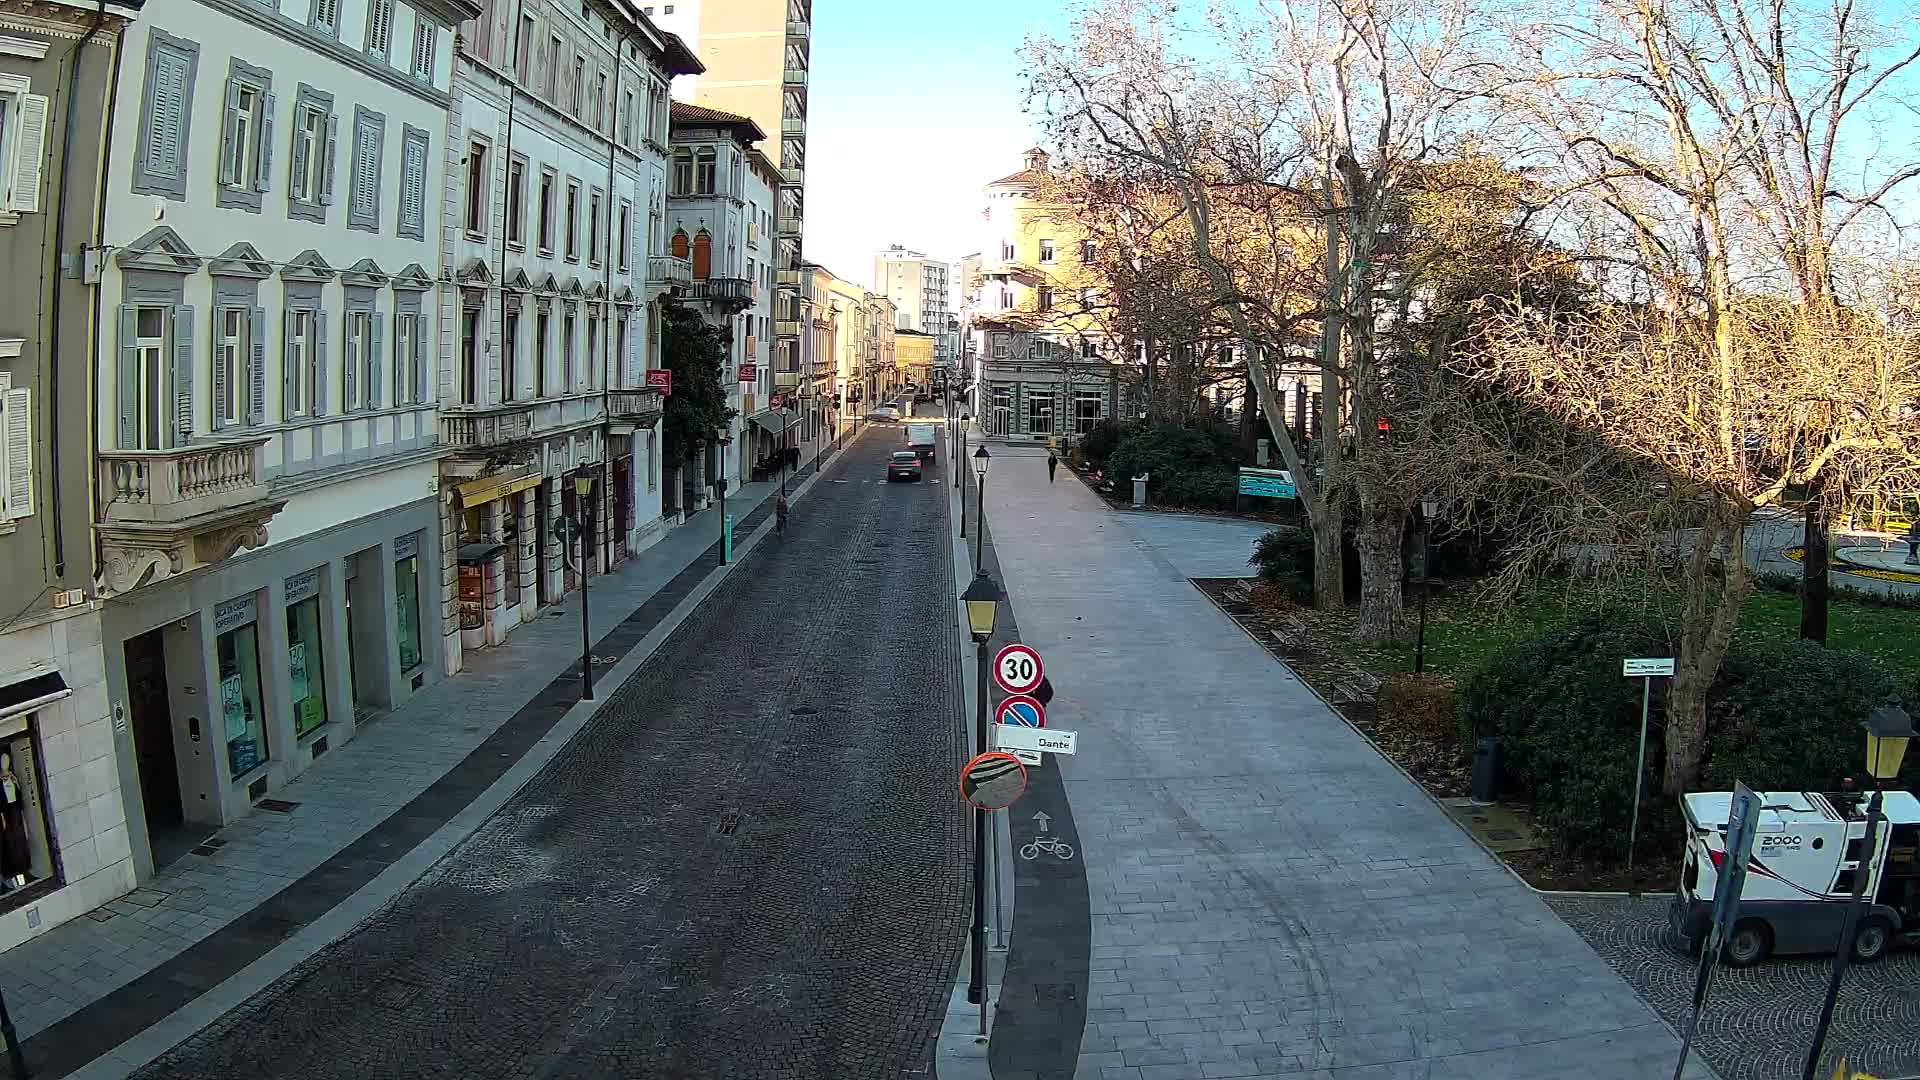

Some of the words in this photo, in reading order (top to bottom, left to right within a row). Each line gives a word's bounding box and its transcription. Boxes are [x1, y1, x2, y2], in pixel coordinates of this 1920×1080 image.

[1006, 658, 1033, 680] 30
[1039, 738, 1070, 749] Dante
[1761, 835, 1802, 845] 2000
